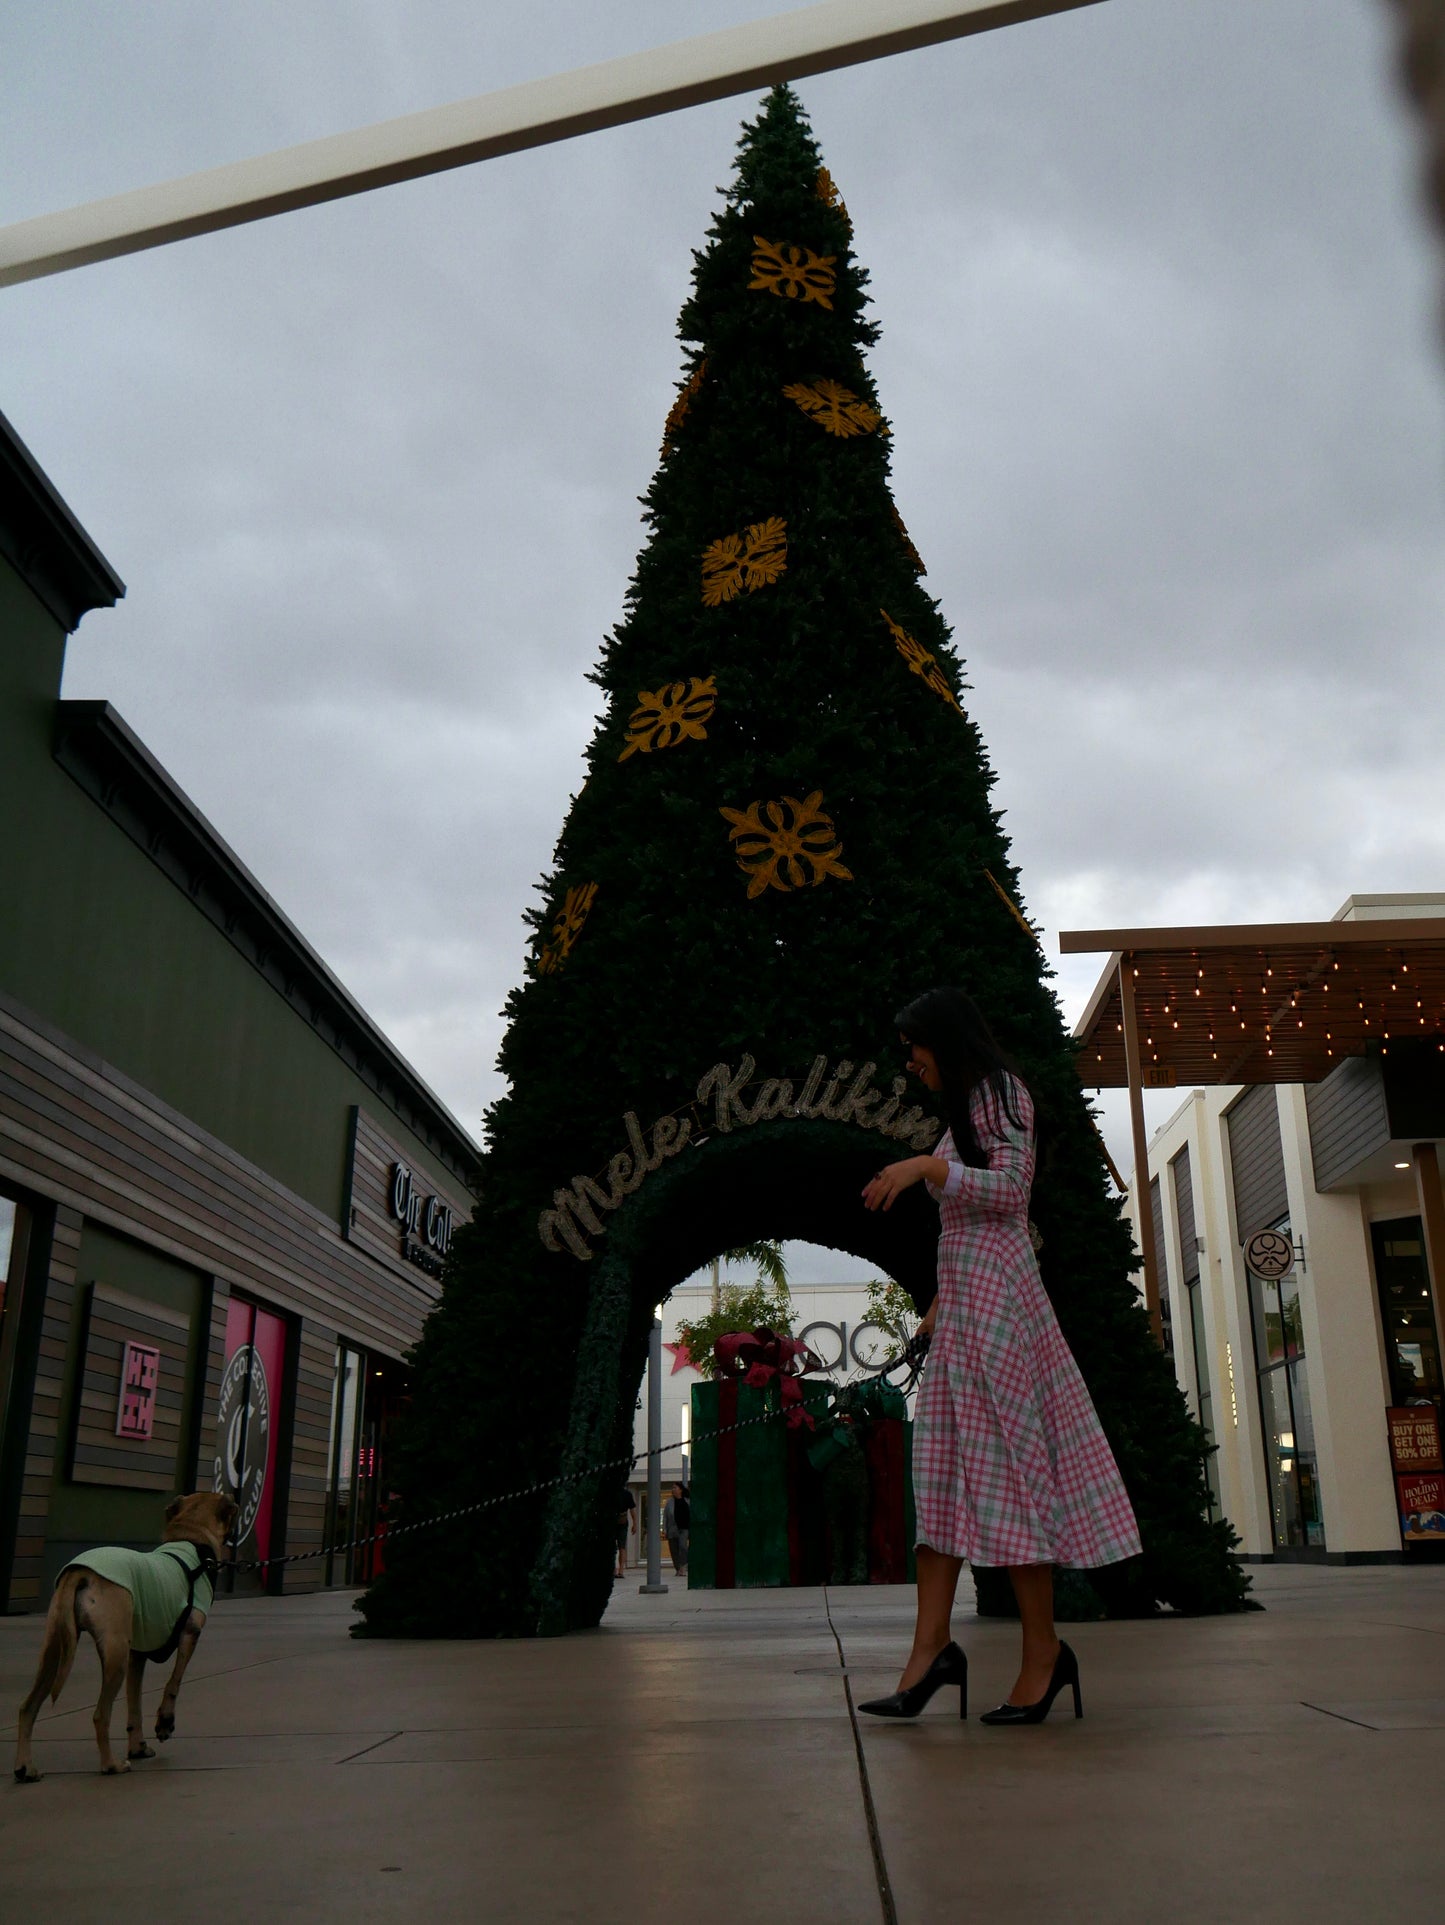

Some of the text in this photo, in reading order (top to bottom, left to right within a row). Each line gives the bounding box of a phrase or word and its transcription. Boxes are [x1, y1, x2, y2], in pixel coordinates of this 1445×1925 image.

[1150, 1070, 1169, 1085] EXIT
[538, 1052, 941, 1261] Mele Kalikim
[392, 1162, 421, 1238] The
[217, 1354, 268, 1435] THE COLECTIVE
[1392, 1423, 1436, 1437] BUY ONE
[1394, 1435, 1438, 1448] GET ONE
[1396, 1446, 1439, 1459] 50% OFF
[1405, 1481, 1439, 1499] HOLIDAY
[1409, 1491, 1438, 1508] DEALS
